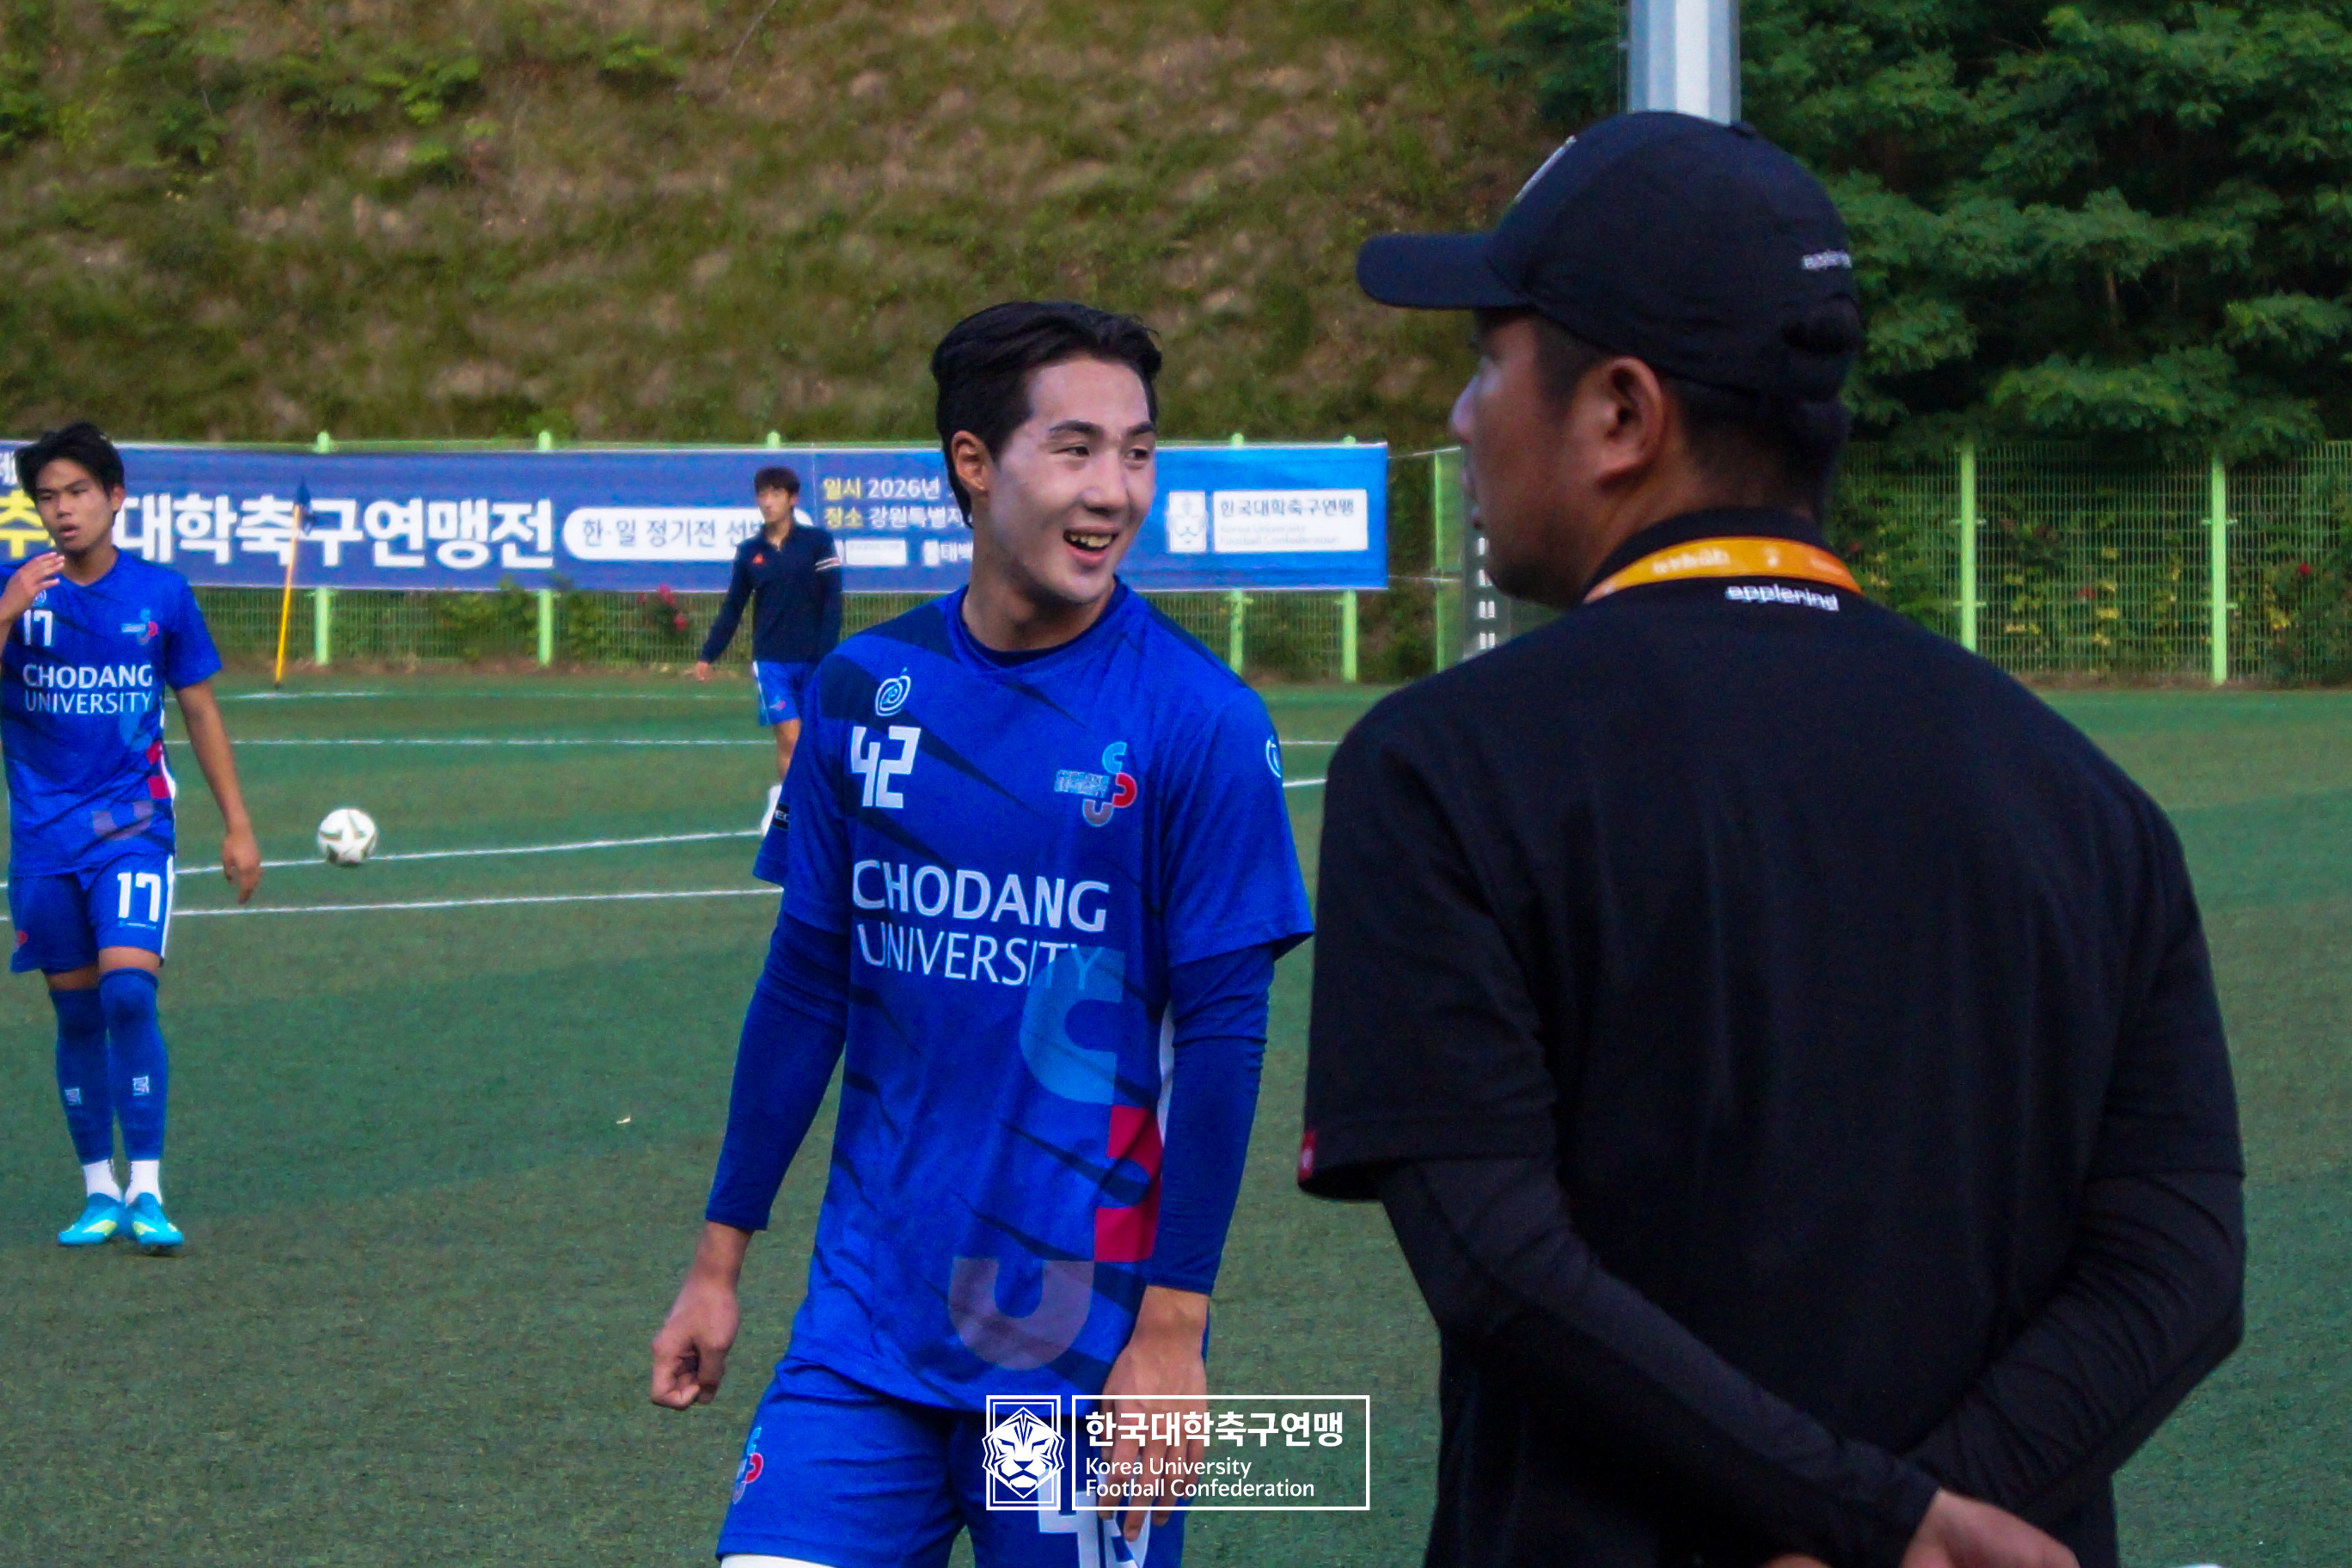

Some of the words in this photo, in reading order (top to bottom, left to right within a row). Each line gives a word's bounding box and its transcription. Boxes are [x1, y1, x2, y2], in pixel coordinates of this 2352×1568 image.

[824, 476, 862, 500] 일시
[867, 475, 940, 500] 2026년
[112, 493, 554, 570] 대학축구연맹전
[646, 518, 716, 548] 정기전
[22, 609, 53, 646] 17
[22, 664, 153, 689] CHODANG
[25, 690, 153, 714] UNIVERSITY
[850, 726, 922, 809] 42
[116, 872, 162, 923] 17
[852, 860, 1110, 933] CHODANG
[856, 922, 1103, 990] UNIVERSITY
